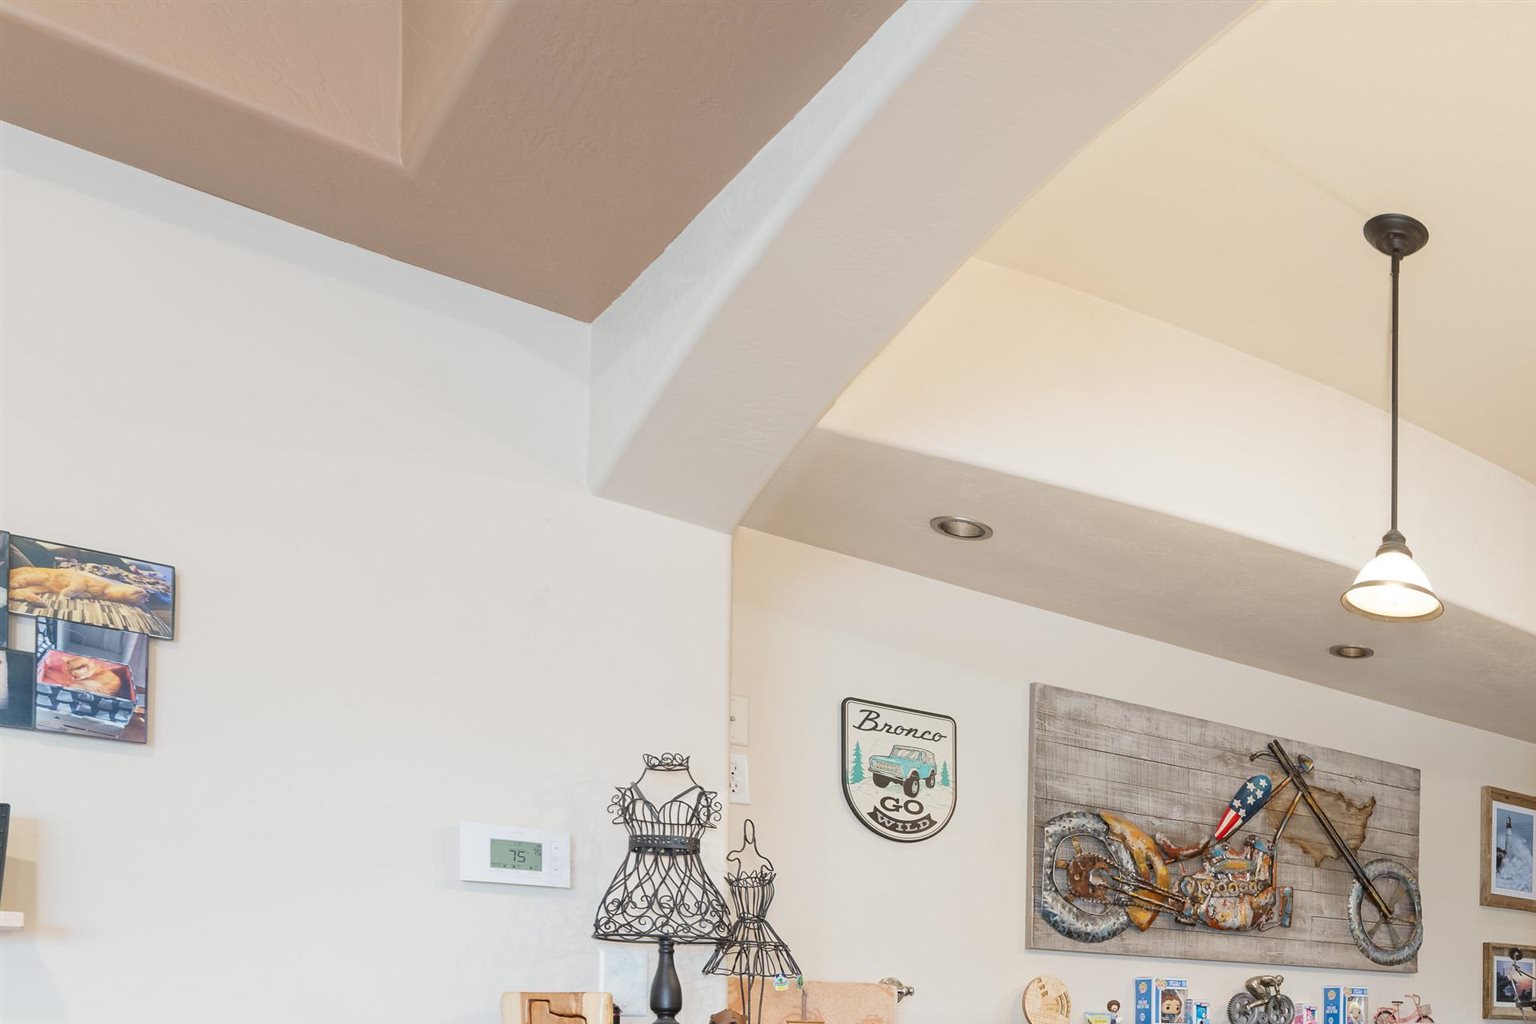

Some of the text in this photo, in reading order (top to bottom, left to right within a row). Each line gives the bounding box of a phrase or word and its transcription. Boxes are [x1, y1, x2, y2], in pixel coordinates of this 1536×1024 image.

[852, 709, 947, 742] Bronco
[880, 796, 924, 815] GO
[875, 812, 930, 832] WILD
[509, 849, 526, 863] 75
